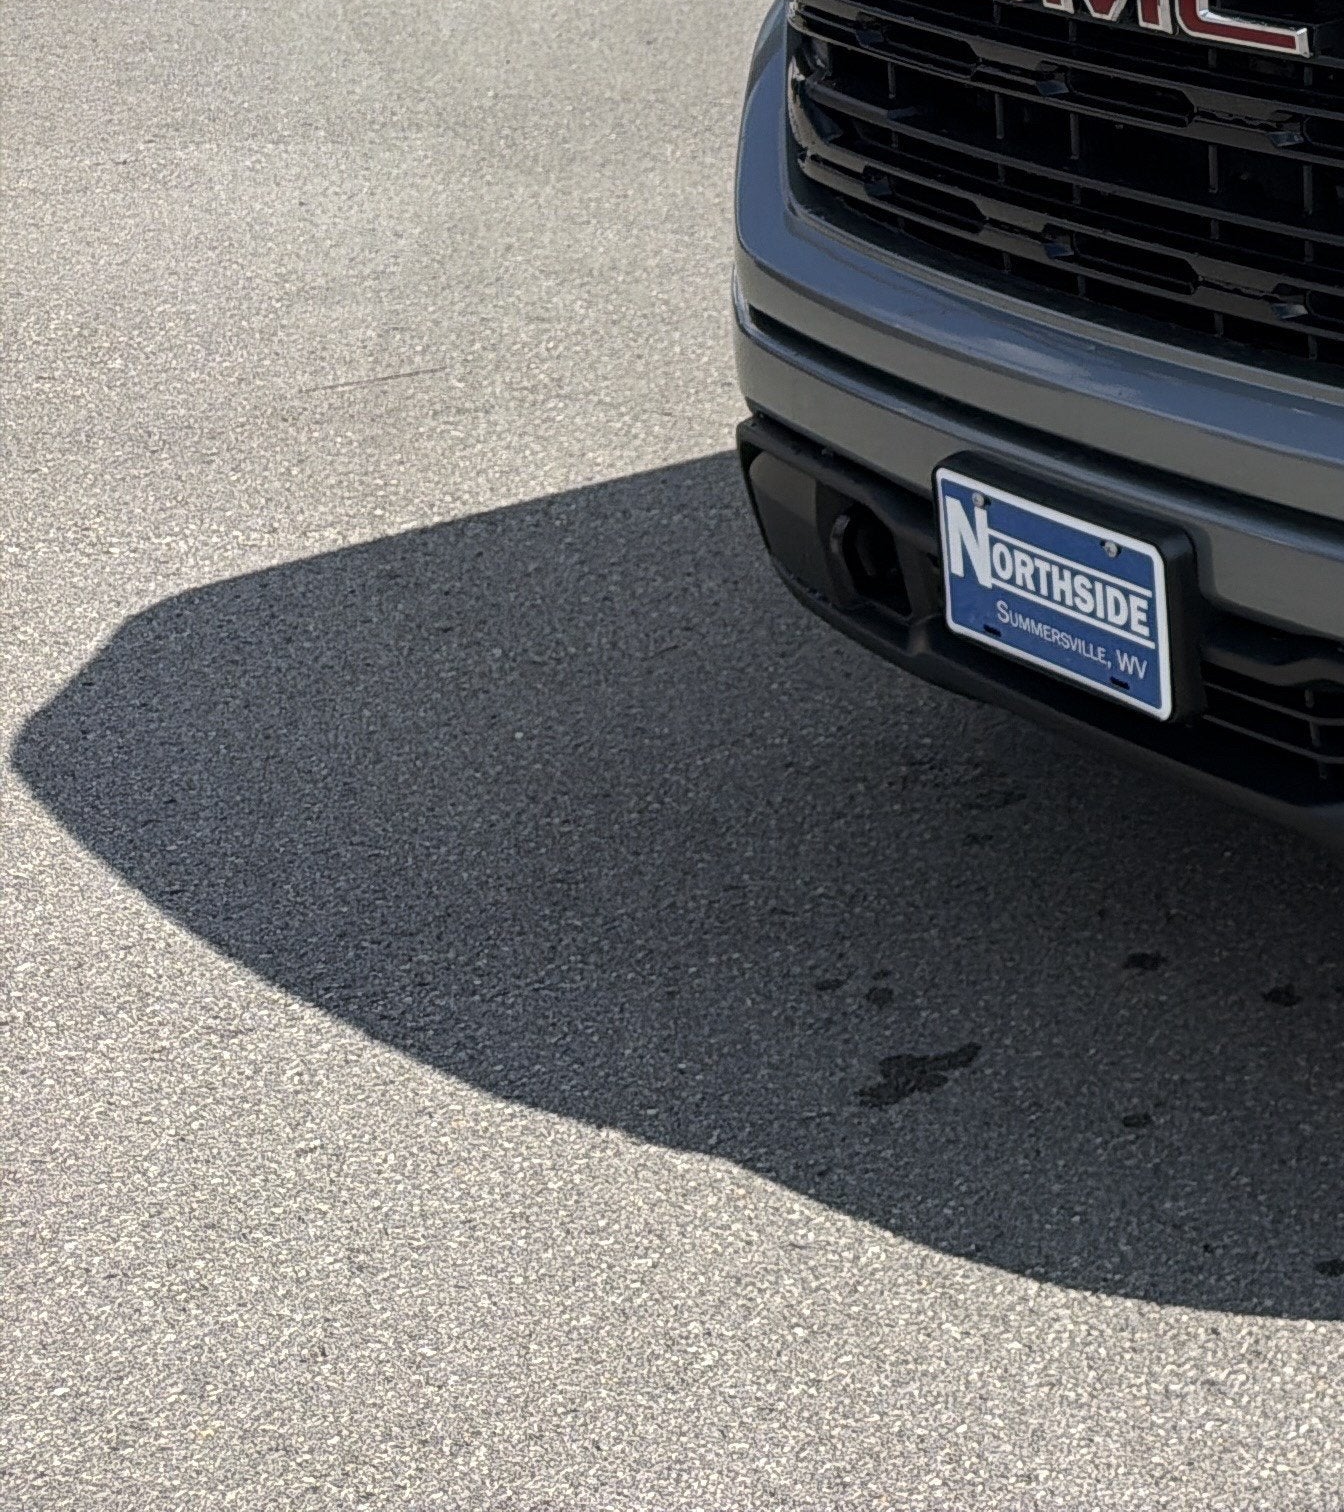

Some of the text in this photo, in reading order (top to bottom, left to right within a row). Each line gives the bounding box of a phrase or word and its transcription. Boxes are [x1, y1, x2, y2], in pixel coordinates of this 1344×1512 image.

[945, 495, 1151, 638] NORTHSIDE
[996, 599, 1148, 680] SUMMERSVILLE, WV
